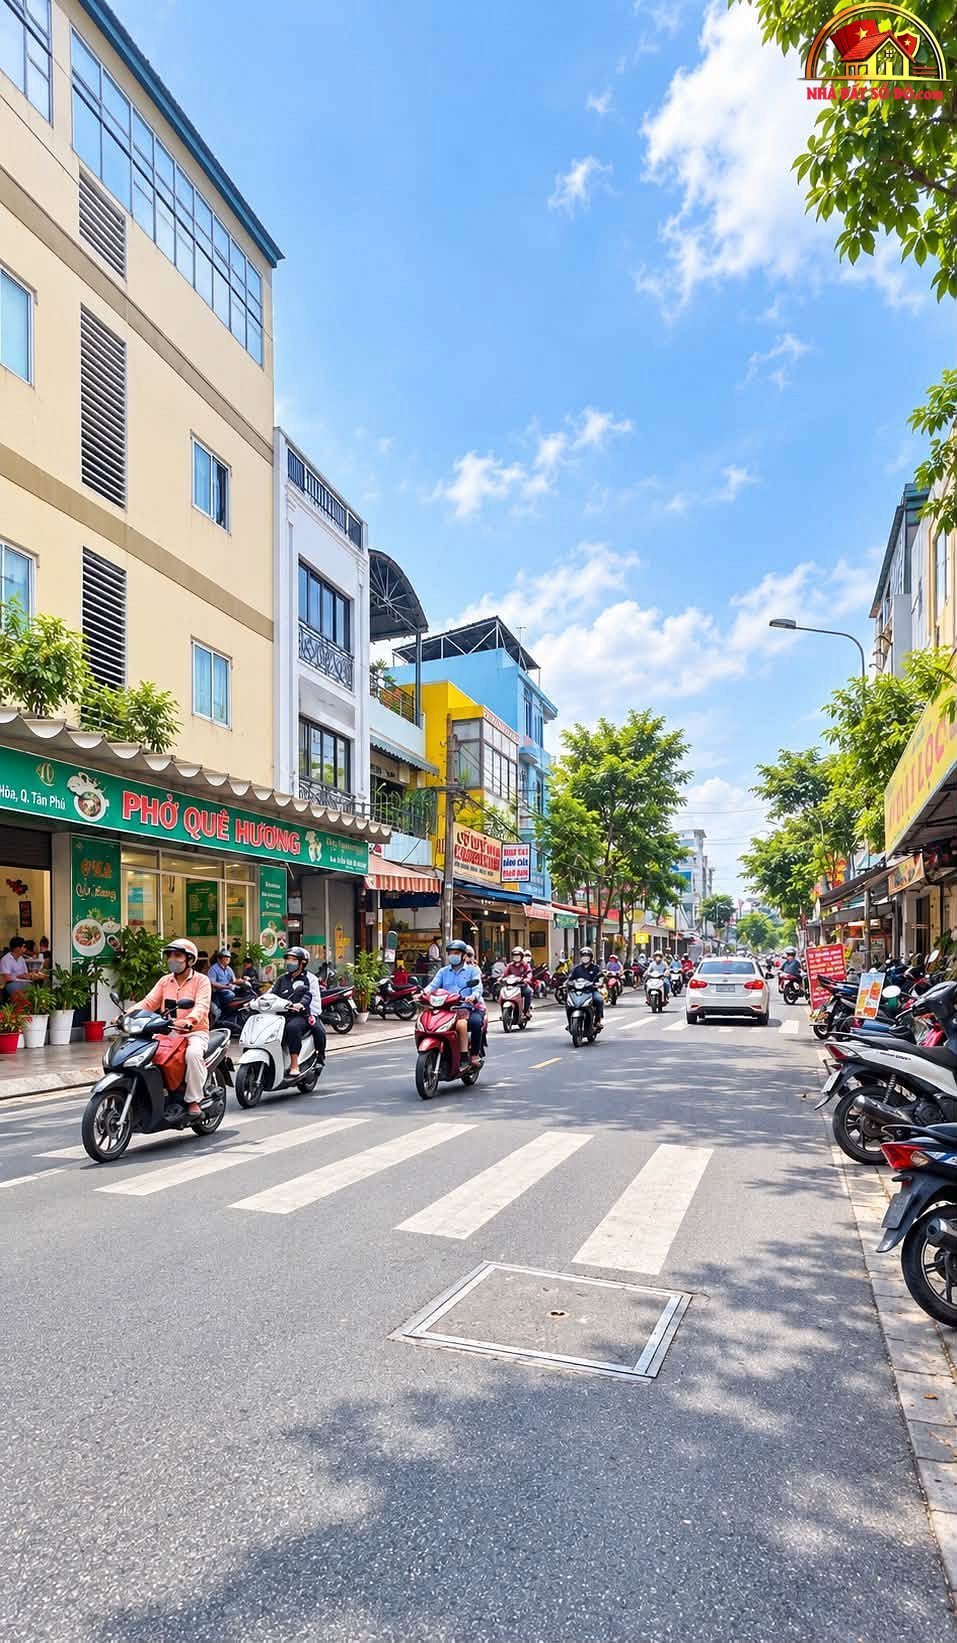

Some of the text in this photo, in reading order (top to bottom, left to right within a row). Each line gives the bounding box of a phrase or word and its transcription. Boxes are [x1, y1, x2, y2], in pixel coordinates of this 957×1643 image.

[20, 789, 30, 803] Q.
[122, 790, 179, 830] PHỞ
[183, 808, 230, 840] QUÊ
[235, 819, 301, 855] HƯƠNG
